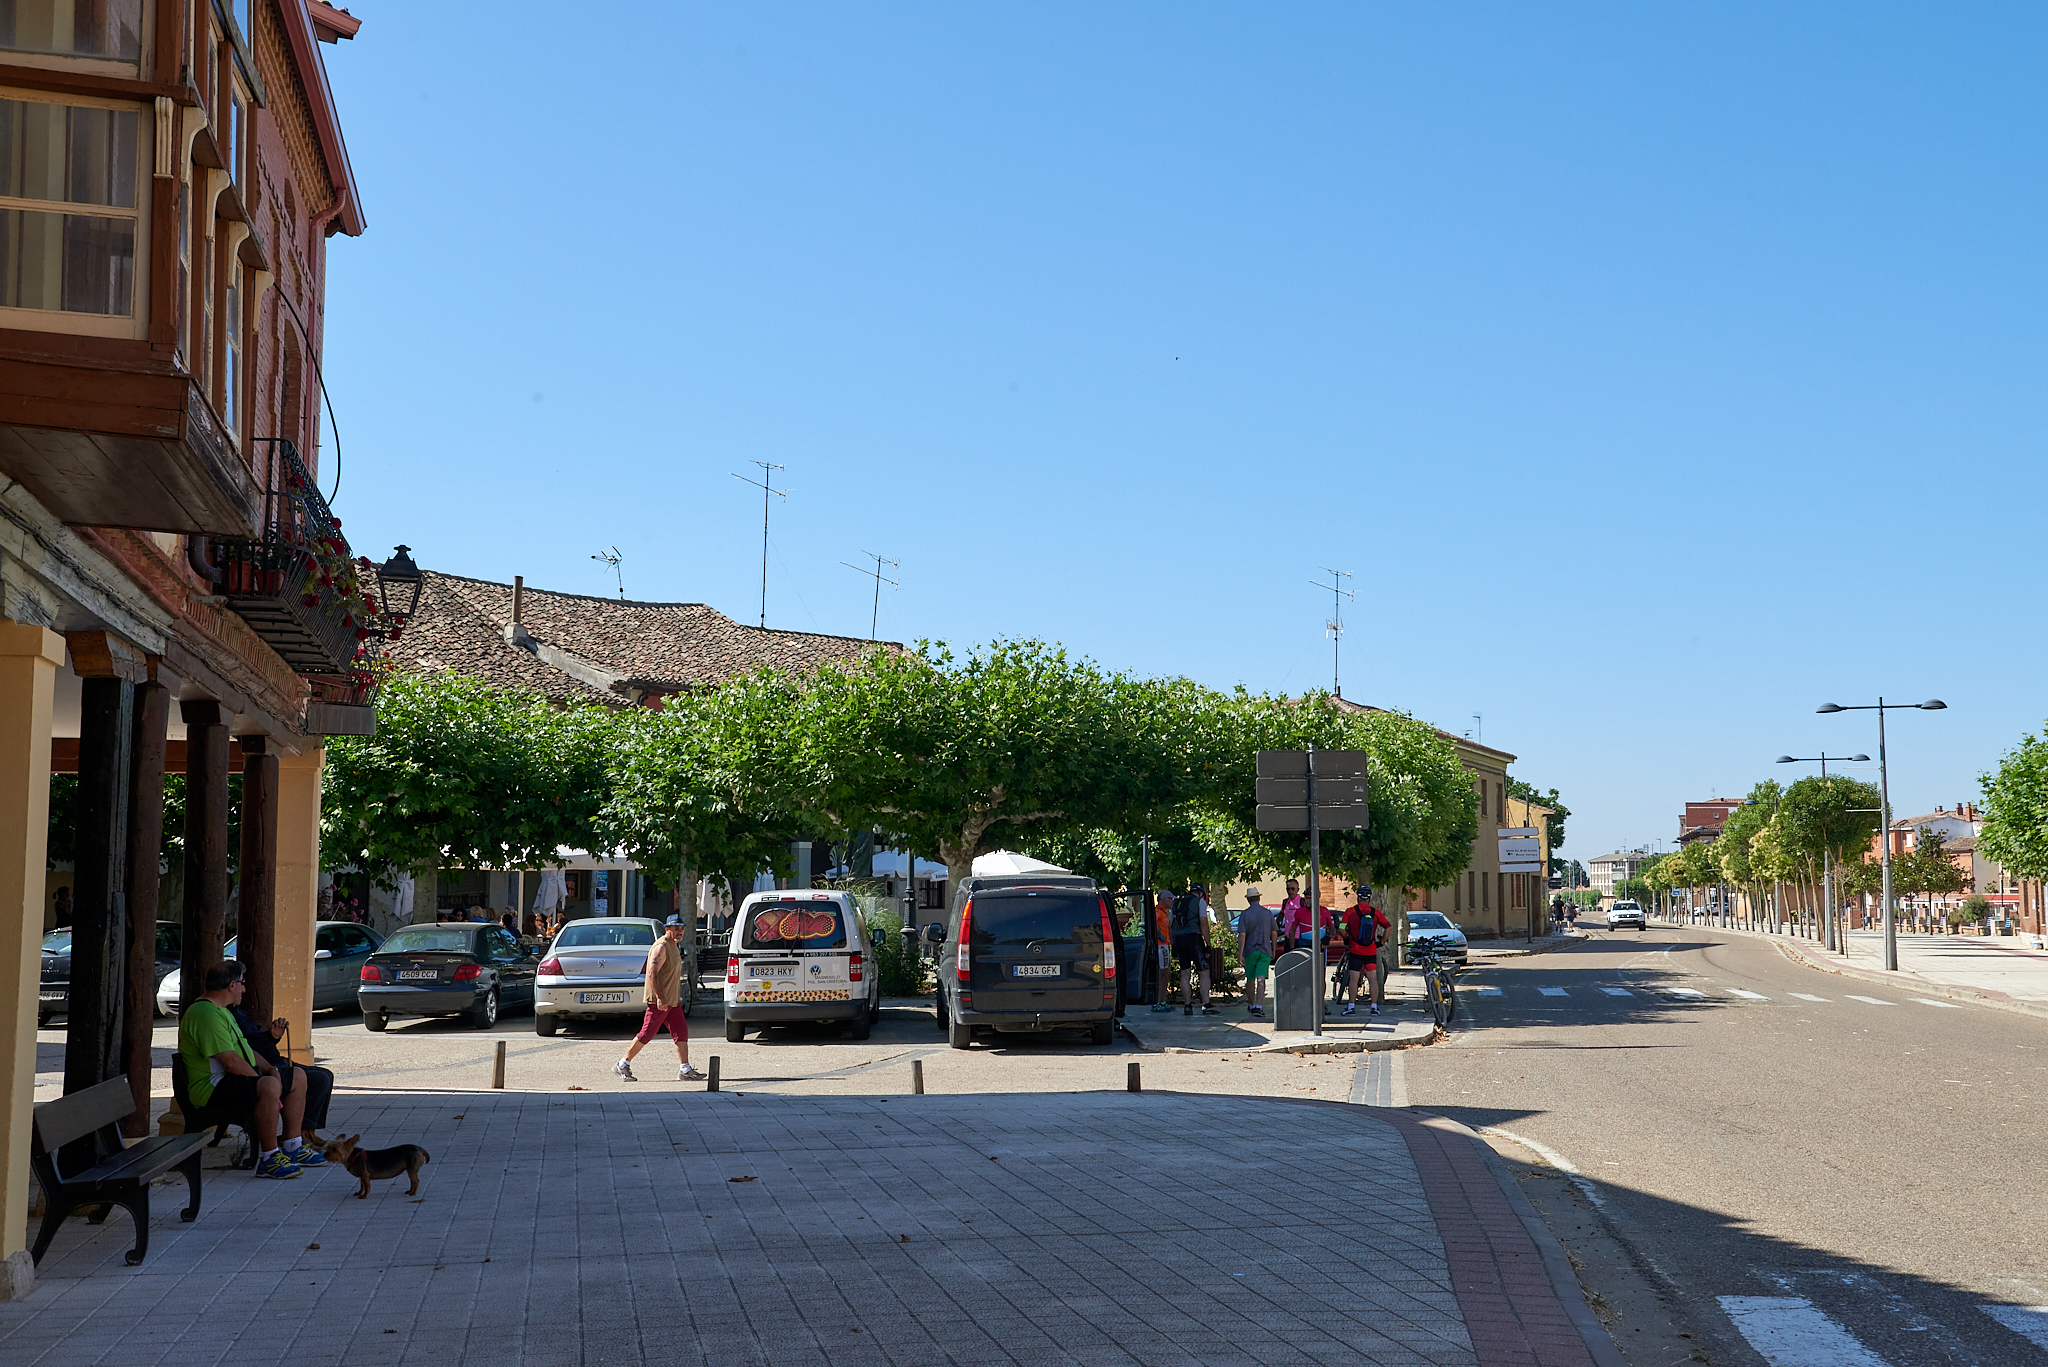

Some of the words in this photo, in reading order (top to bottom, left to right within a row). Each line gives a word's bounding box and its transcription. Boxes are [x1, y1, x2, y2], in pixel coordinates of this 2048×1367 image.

[401, 970, 420, 979] 4509
[421, 970, 436, 979] CCZ
[755, 967, 775, 976] 0823
[1018, 966, 1039, 975] 4834
[1041, 966, 1057, 975] GFK
[585, 993, 604, 1001] 8072
[606, 993, 621, 1001] FVN
